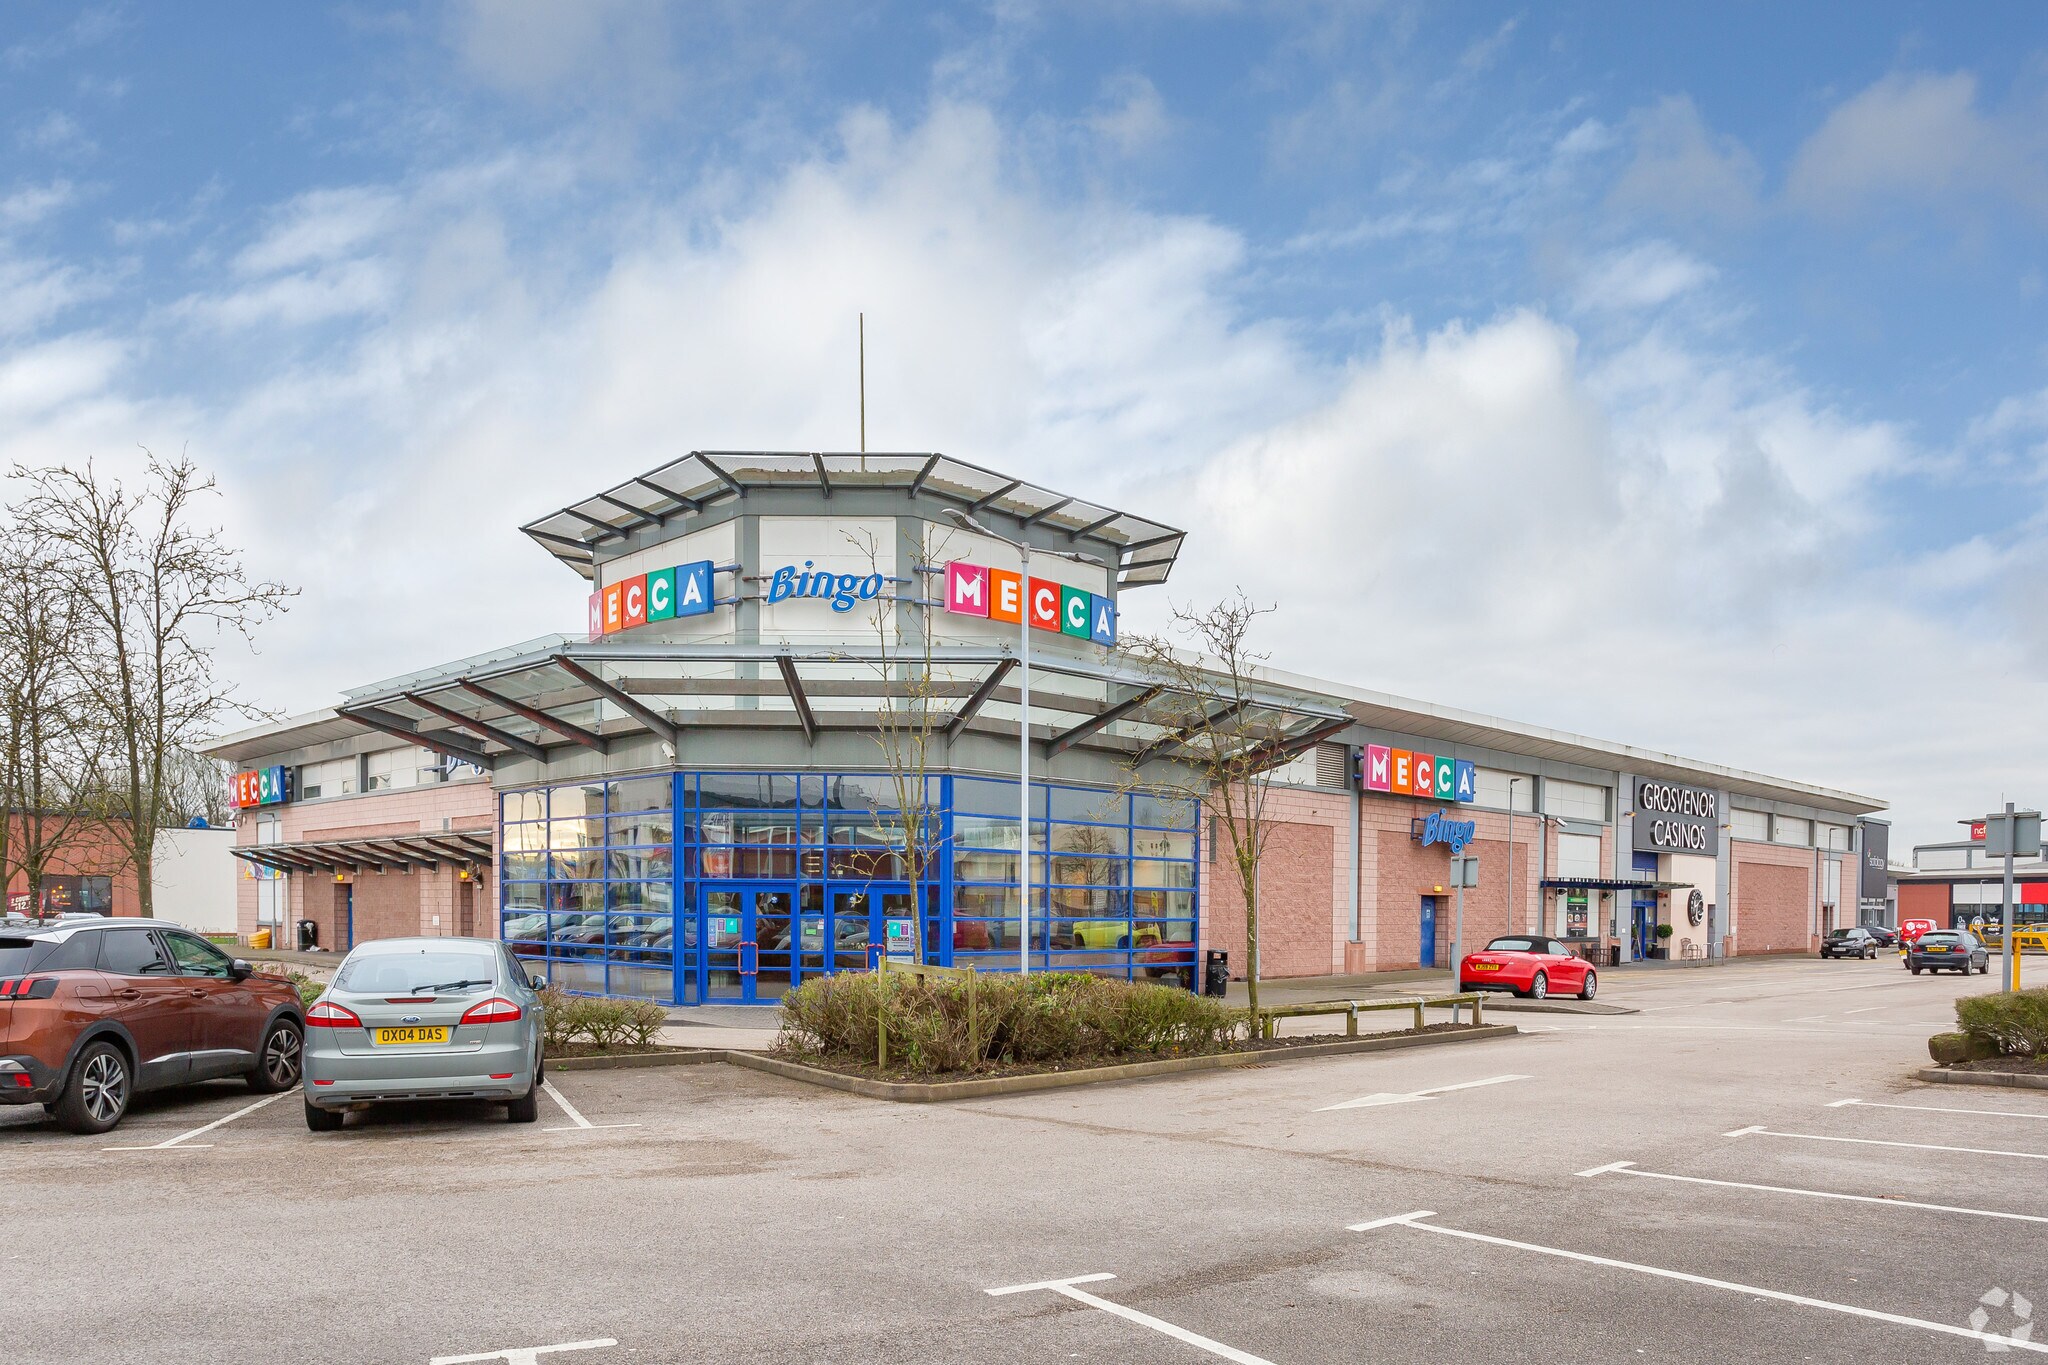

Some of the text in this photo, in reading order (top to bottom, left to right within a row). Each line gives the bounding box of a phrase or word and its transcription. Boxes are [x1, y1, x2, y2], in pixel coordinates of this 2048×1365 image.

[590, 572, 703, 632] MECCA
[767, 560, 885, 613] Bingo
[955, 571, 1111, 636] MECCA
[230, 773, 282, 803] MECCA
[1372, 753, 1471, 795] MECCA
[1642, 783, 1716, 818] GROSVENOR
[1422, 808, 1476, 854] Bingo
[1653, 819, 1706, 850] CASINOS
[382, 1028, 442, 1042] OX04 DAS
